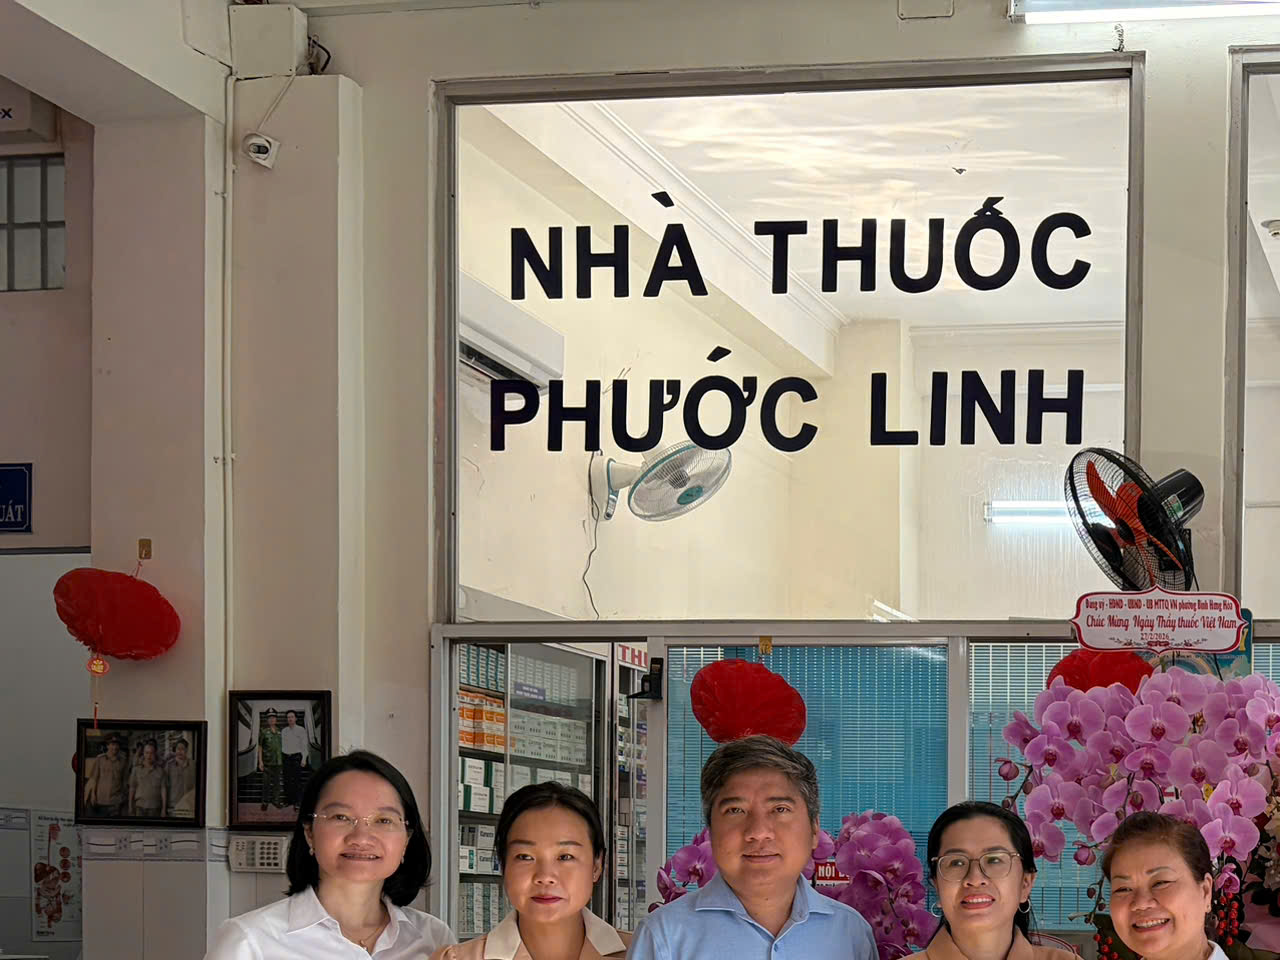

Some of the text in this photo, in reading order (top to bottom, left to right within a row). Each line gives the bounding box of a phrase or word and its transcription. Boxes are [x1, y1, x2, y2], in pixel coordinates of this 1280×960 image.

[511, 191, 1092, 300] NHÀ THUỐC
[489, 345, 1085, 452] PHƯỚC LINH
[1086, 612, 1237, 631] Chúc Mừng Ngày Thầy thuốc Việt Nam
[1140, 632, 1169, 640] 27/2/2026
